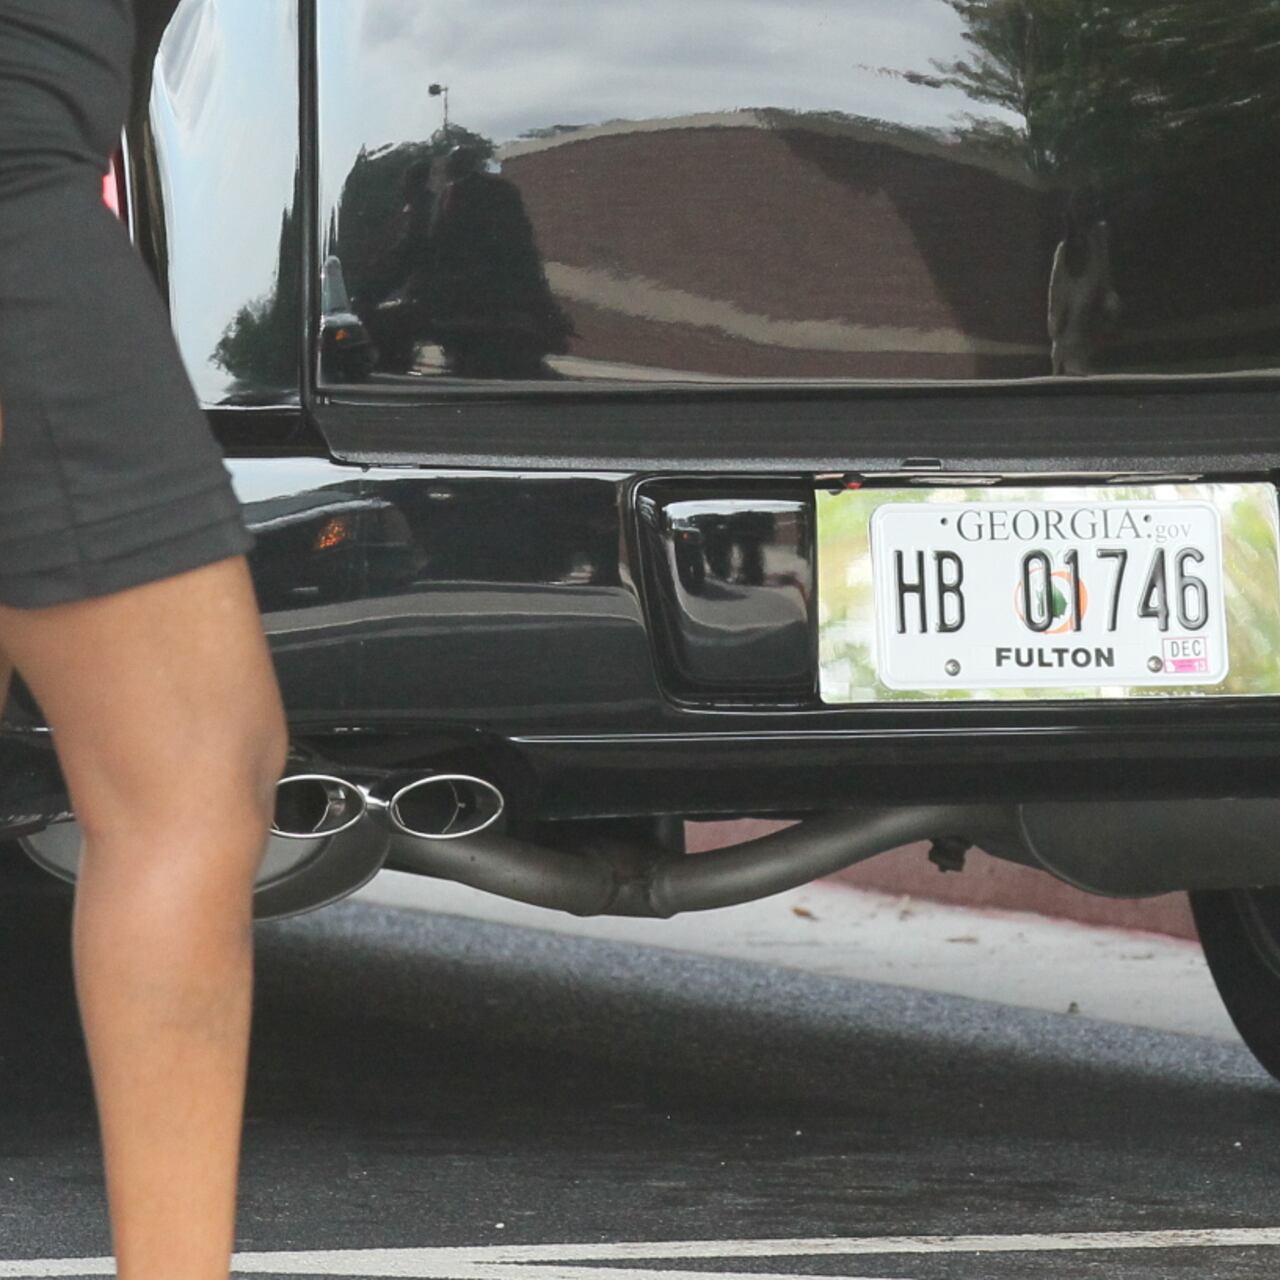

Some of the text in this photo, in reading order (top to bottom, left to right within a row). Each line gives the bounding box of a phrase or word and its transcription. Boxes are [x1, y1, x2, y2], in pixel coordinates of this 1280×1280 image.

[893, 547, 1209, 634] HB 01746
[995, 647, 1116, 668] FULTON
[1170, 639, 1202, 658] DEC
